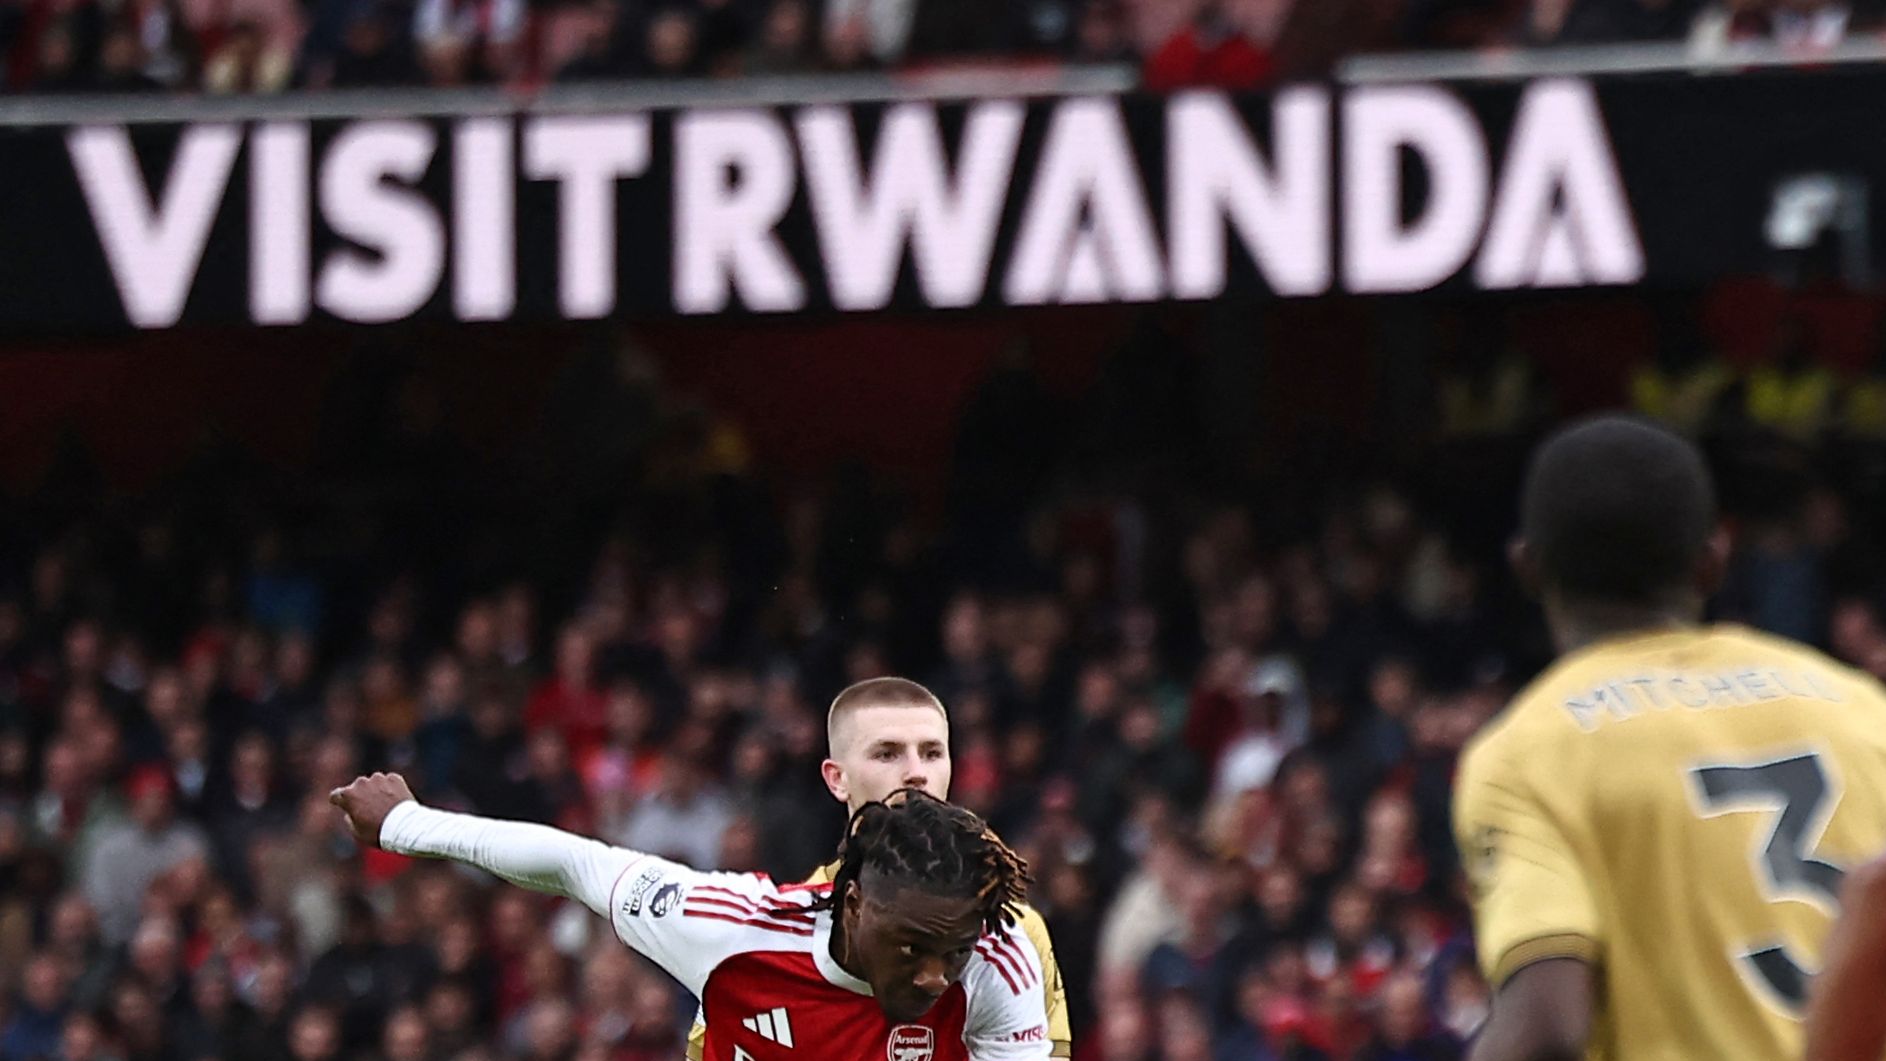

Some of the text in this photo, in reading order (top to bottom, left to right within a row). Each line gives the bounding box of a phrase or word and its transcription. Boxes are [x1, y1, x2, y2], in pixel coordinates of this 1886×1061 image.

[71, 82, 1643, 326] VISIT RWANDA
[1564, 670, 1844, 733] MITCHELL
[1686, 744, 1848, 1020] 3
[895, 1034, 929, 1045] Arsenal
